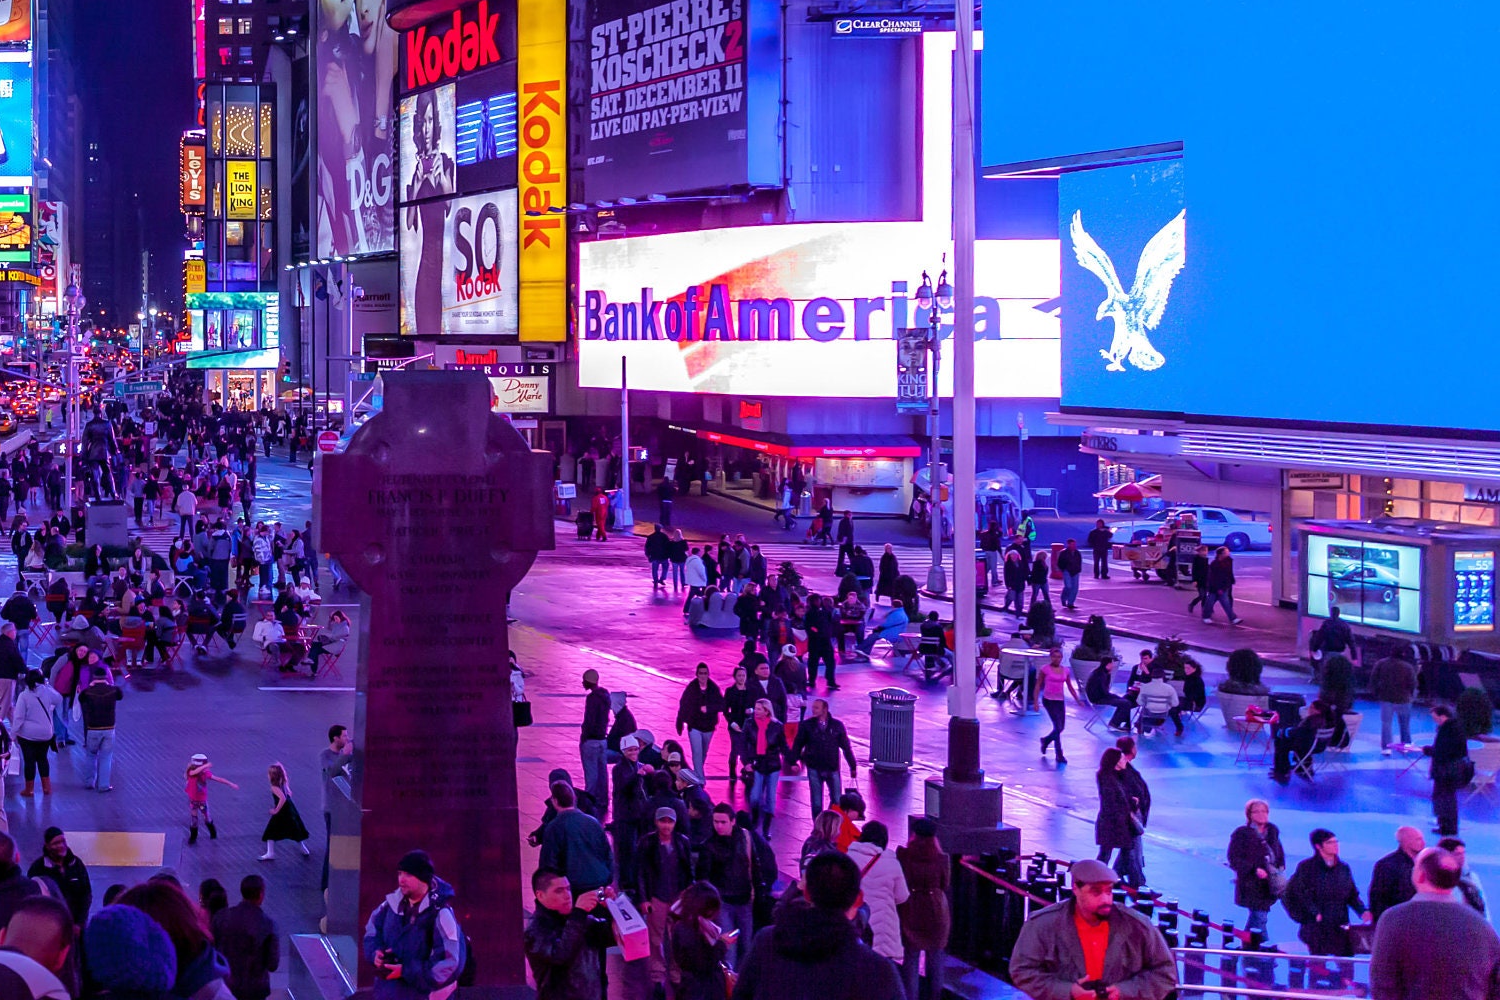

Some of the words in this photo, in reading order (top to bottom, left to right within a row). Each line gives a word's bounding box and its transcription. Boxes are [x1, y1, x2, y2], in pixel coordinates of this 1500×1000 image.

[406, 0, 501, 90] Kodak
[591, 25, 726, 95] KOSCHECK
[725, 20, 743, 61] 2
[591, 93, 622, 121] SAT.
[625, 69, 721, 113] DECEMBER
[725, 64, 743, 91] 11
[591, 117, 621, 140] LIVE
[622, 113, 640, 134] ON
[642, 92, 742, 130] PAY-PER-VIEW
[233, 172, 250, 181] THE
[350, 152, 391, 210] D&G
[522, 79, 560, 250] Kodak
[230, 182, 252, 196] LION
[230, 198, 253, 212] KING
[453, 201, 502, 287] SO
[456, 263, 502, 302] Kodak
[584, 286, 664, 341] Bank
[665, 284, 698, 341] of
[704, 281, 1001, 342] America
[502, 378, 540, 393] Donny
[898, 374, 926, 384] KING
[900, 384, 926, 398] TUT
[368, 488, 431, 505] FRANCIS
[454, 488, 510, 504] DUFFY
